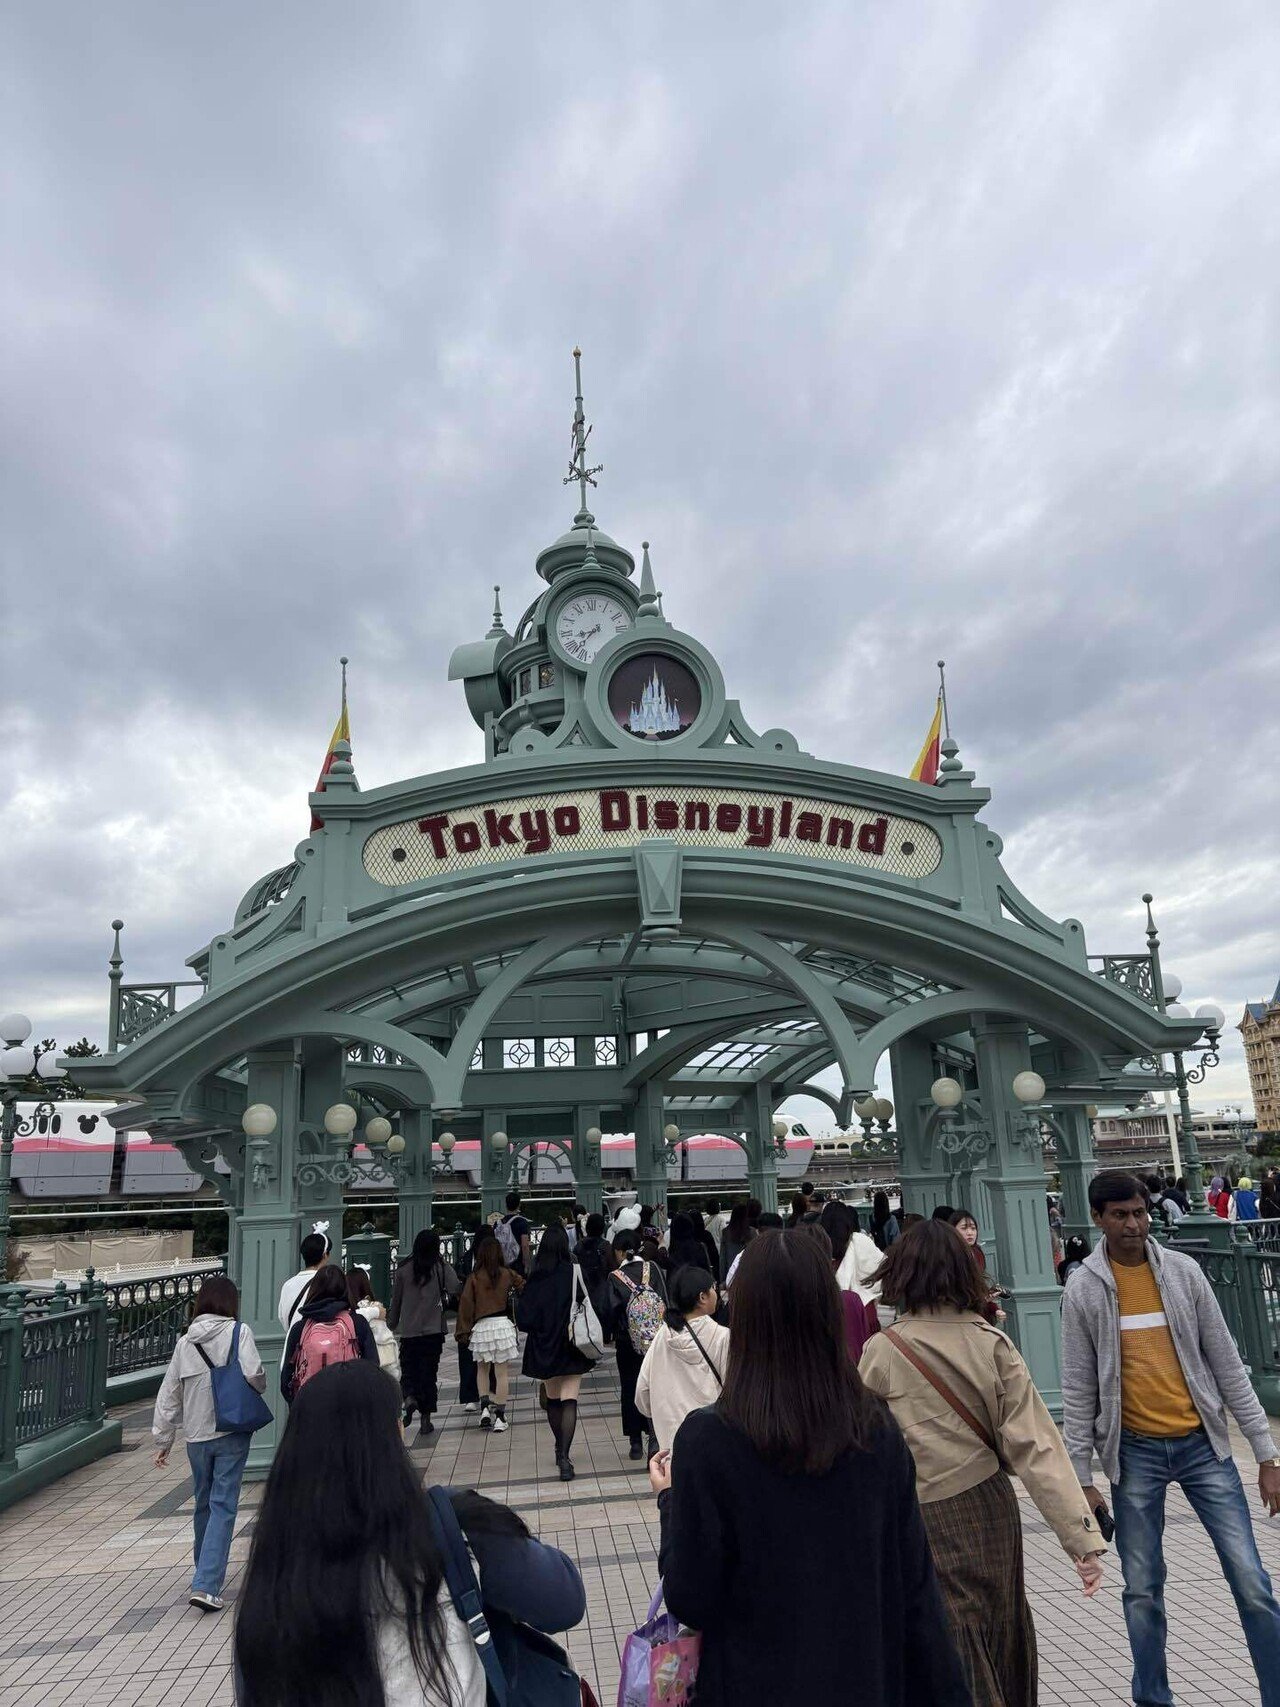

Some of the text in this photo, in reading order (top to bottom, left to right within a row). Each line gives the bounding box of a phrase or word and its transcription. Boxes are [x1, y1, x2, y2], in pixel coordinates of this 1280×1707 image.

[586, 599, 597, 611] XII
[418, 791, 888, 859] Tokyo Disneyland
